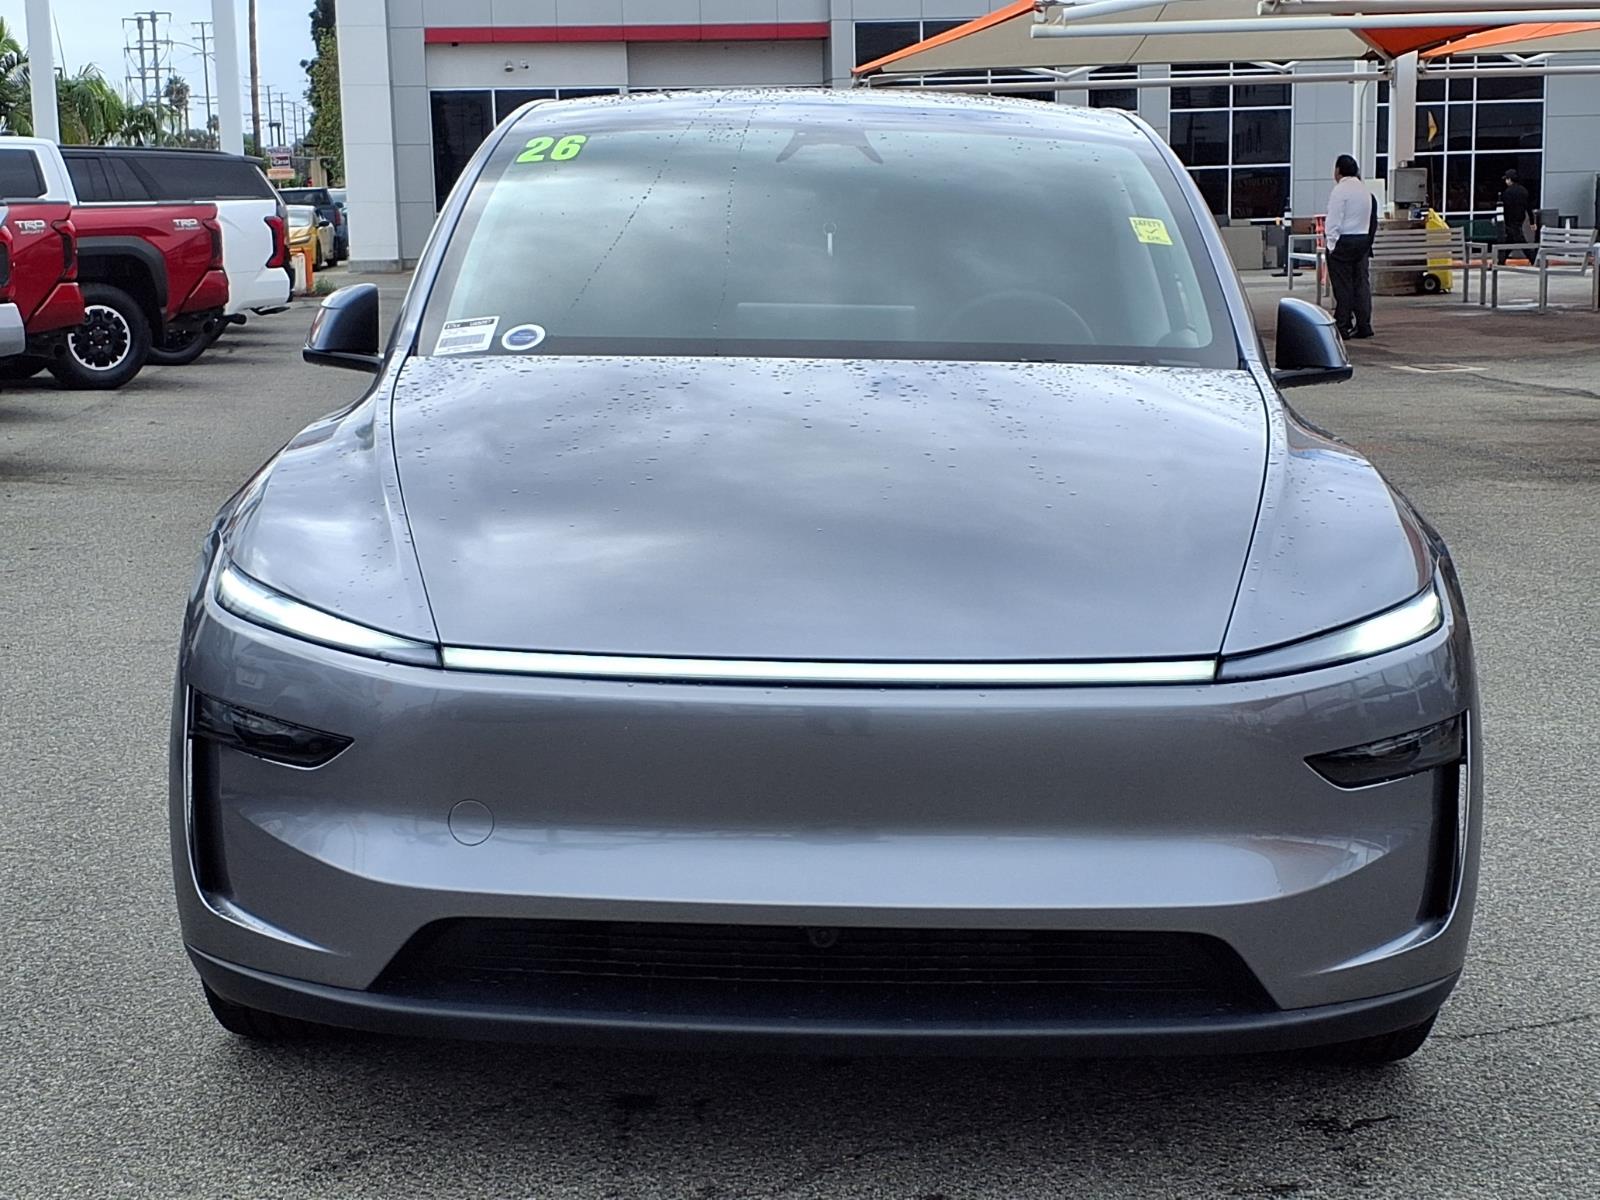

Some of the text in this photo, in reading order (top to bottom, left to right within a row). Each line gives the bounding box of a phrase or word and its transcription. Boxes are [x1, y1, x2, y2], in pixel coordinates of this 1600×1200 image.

[516, 134, 587, 163] 26
[14, 219, 46, 230] TRD
[172, 218, 198, 227] TRD
